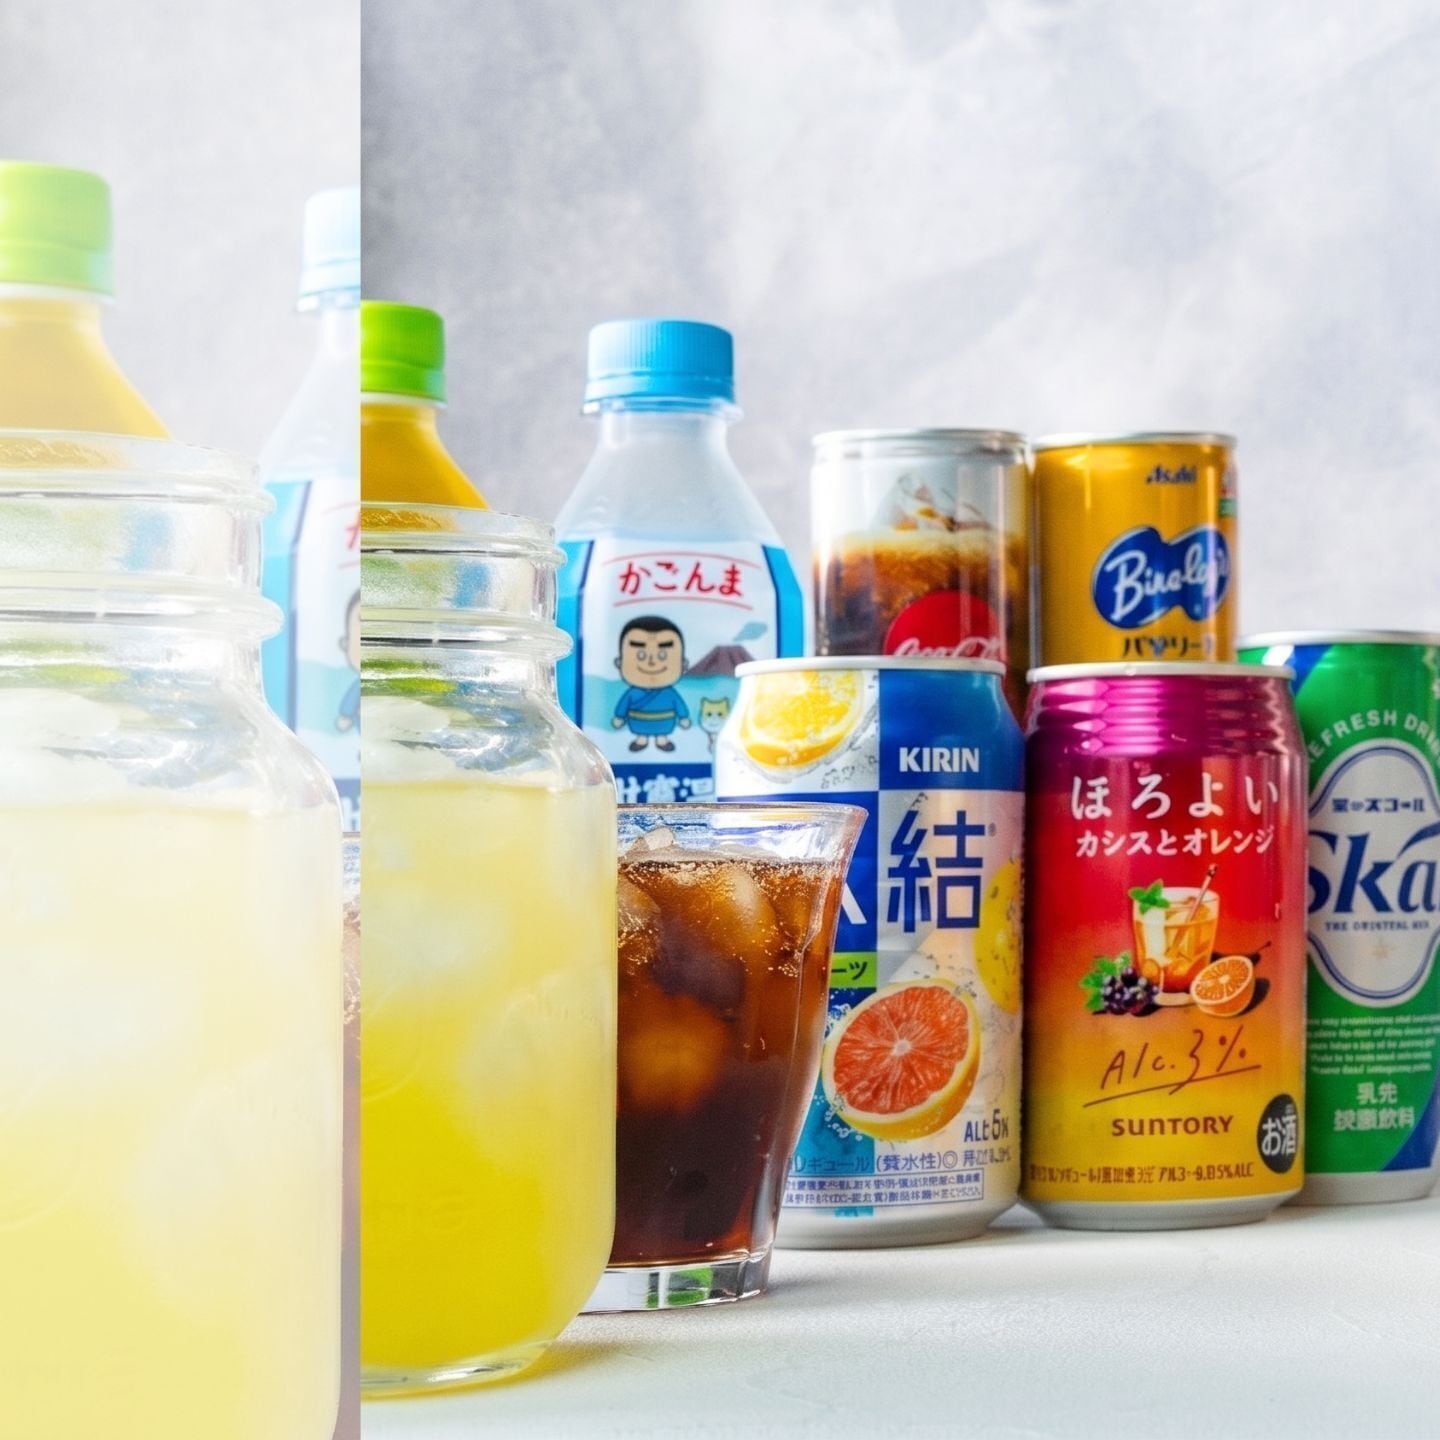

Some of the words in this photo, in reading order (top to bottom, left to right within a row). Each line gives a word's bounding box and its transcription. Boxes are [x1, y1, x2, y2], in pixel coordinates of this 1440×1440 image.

[618, 561, 743, 597] かごんま
[899, 747, 980, 773] KIRIN
[1071, 772, 1279, 820] ほろよい
[1076, 825, 1275, 858] カシスとオレンジ
[1100, 1043, 1175, 1090] Alc.
[1168, 1025, 1247, 1095] 3%
[1111, 1115, 1233, 1136] SUNTORY
[1261, 1114, 1297, 1156] お酒
